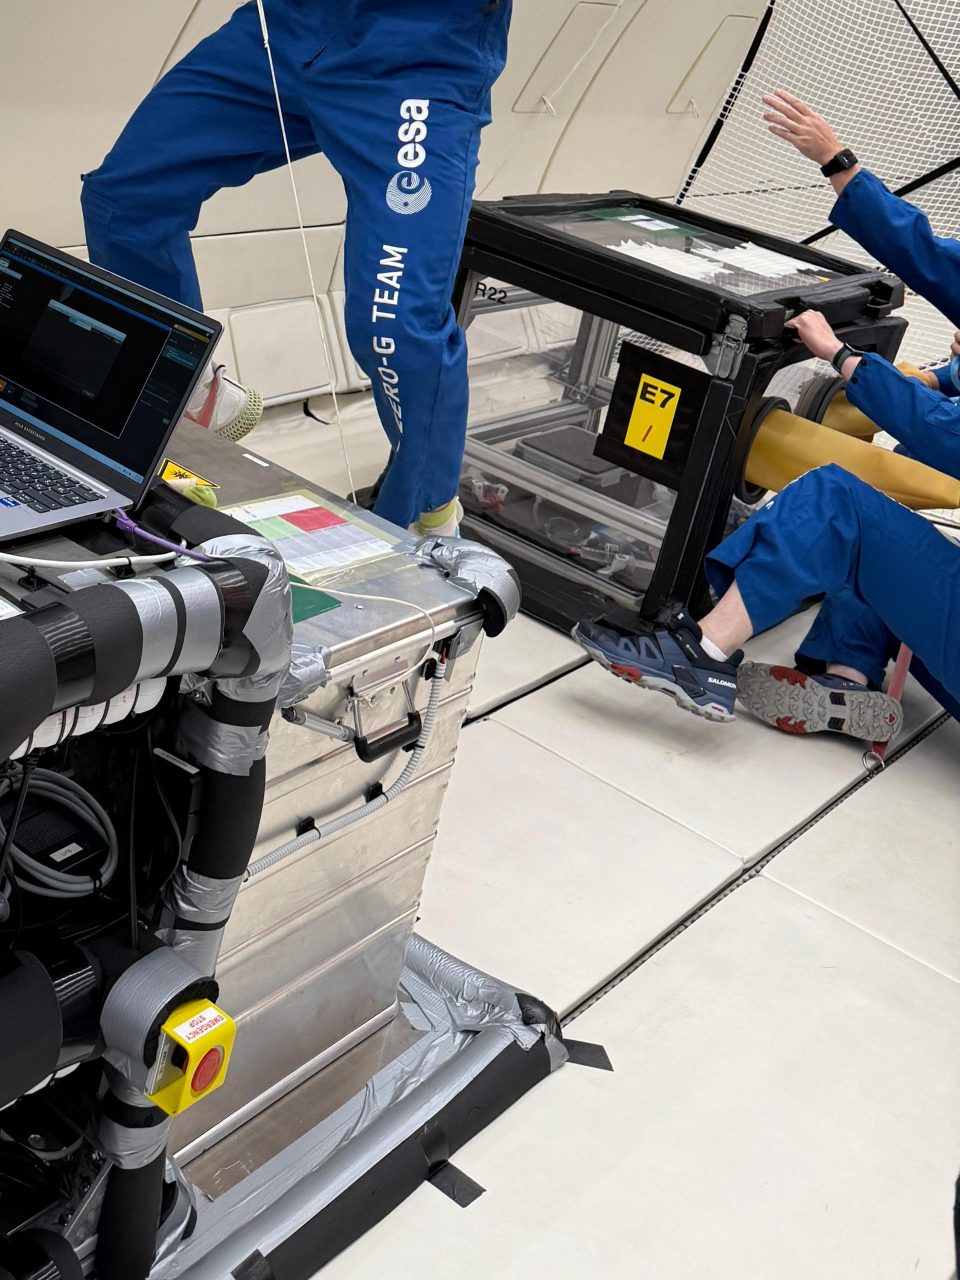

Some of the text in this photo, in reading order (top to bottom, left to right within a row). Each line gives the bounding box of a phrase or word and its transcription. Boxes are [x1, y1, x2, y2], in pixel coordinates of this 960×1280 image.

[397, 98, 430, 168] esa
[371, 244, 408, 323] TEAM
[474, 281, 508, 304] R22
[639, 381, 676, 409] E7
[185, 1014, 225, 1041] EMERGENCY
[189, 1014, 207, 1028] STOP
